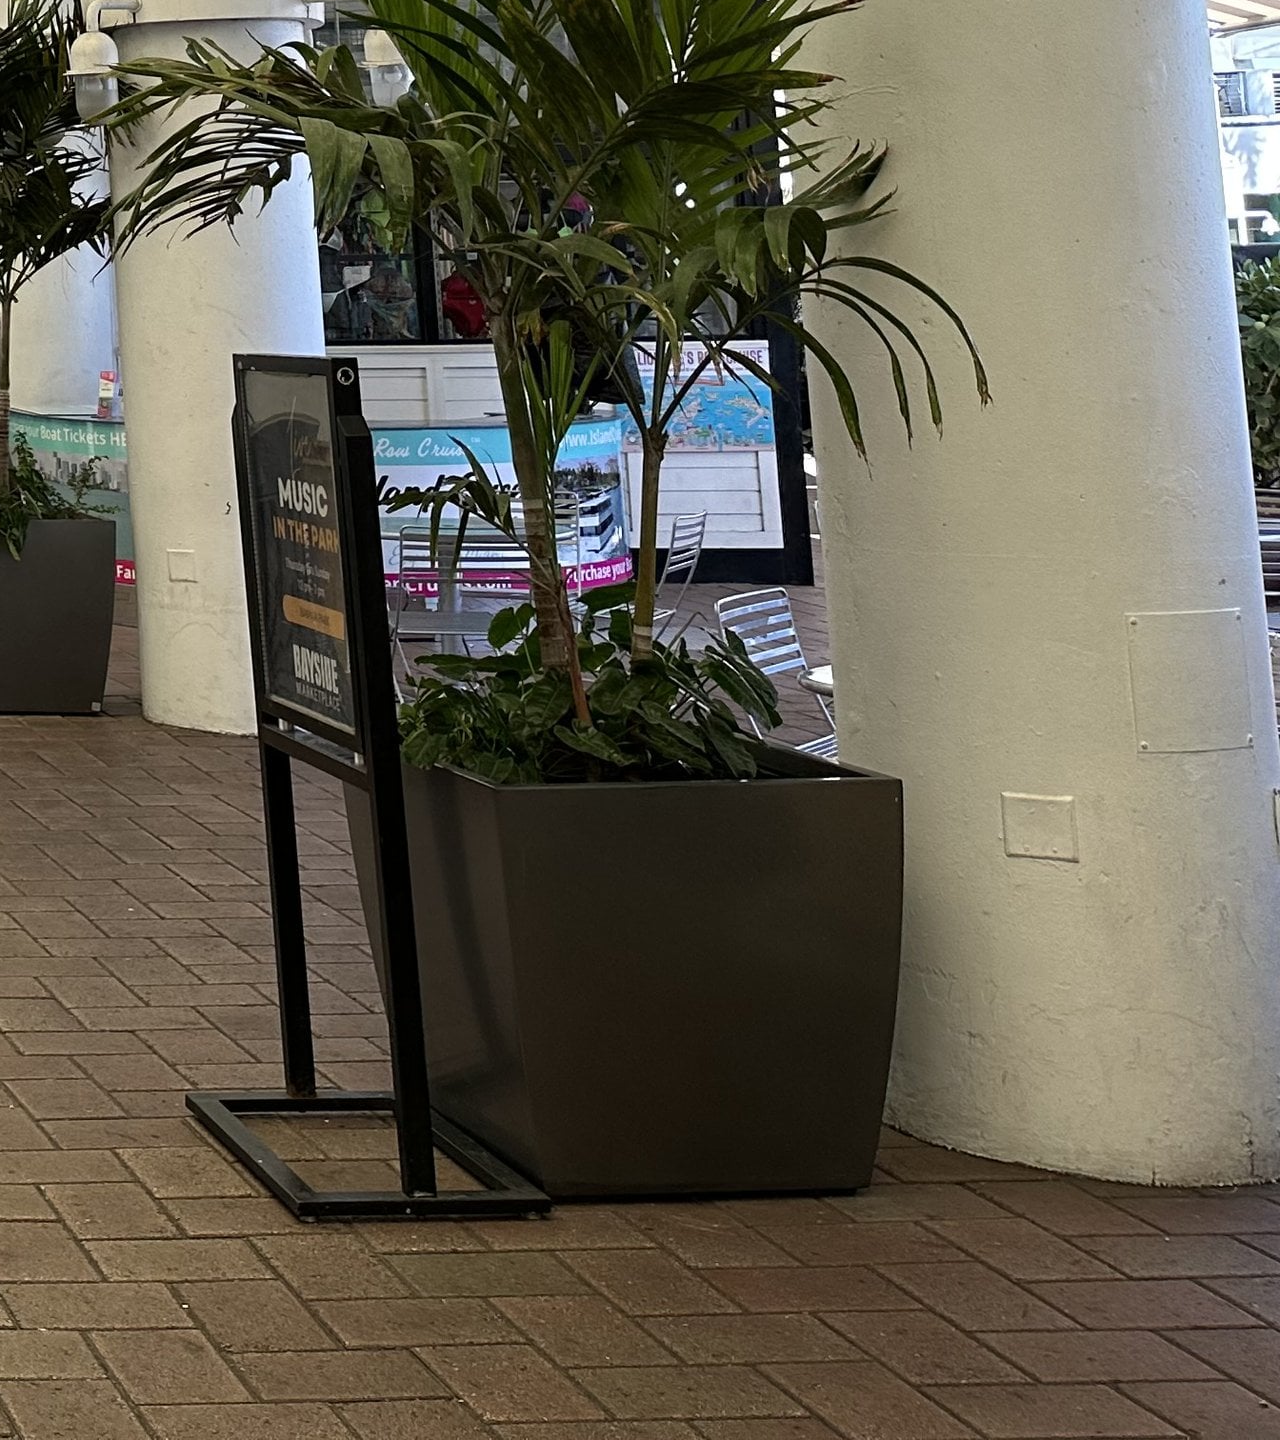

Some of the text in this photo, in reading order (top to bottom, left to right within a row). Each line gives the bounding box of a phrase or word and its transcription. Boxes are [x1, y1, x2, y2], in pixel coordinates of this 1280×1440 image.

[40, 425, 62, 442] Boat
[63, 428, 106, 445] Tickets
[110, 432, 127, 447] HE
[374, 438, 409, 457] Row
[417, 437, 466, 457] Cruis
[277, 477, 328, 518] MUSIC
[273, 516, 339, 553] IN THE PARK
[566, 564, 611, 583] Purchase
[611, 561, 626, 580] your
[293, 644, 339, 695] BAYSIDE
[296, 681, 341, 712] MARKETPLACE
